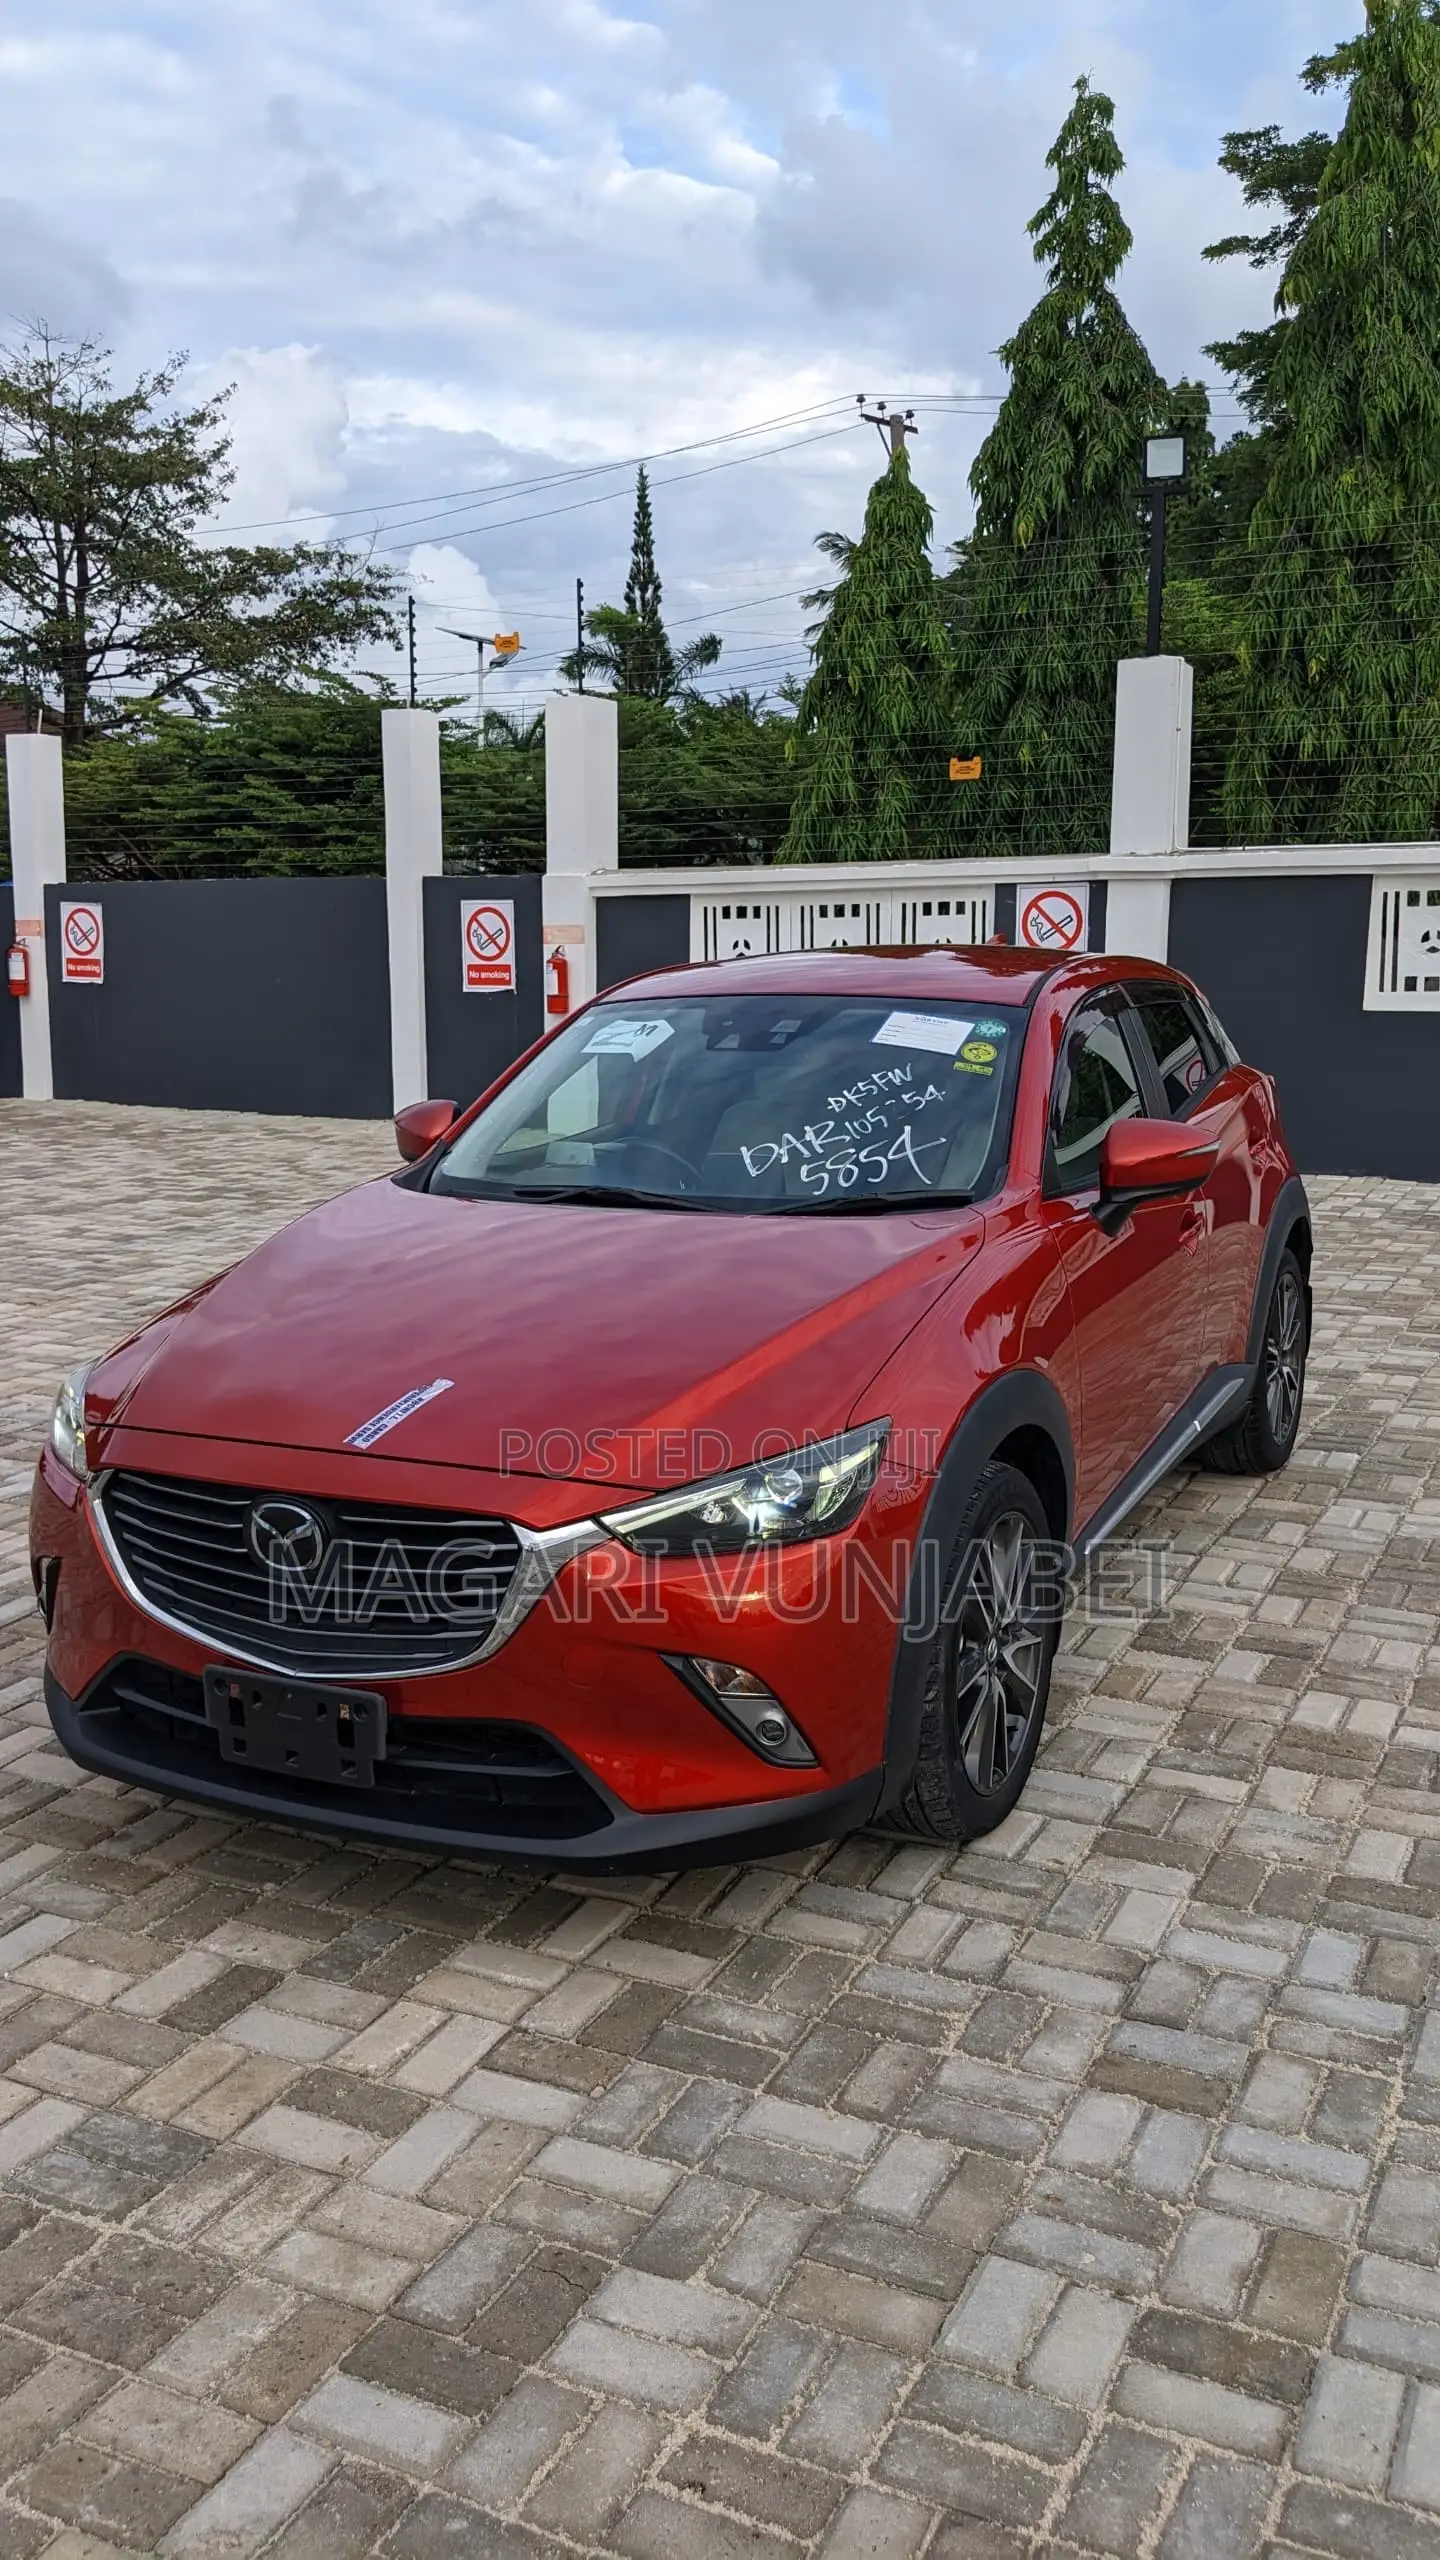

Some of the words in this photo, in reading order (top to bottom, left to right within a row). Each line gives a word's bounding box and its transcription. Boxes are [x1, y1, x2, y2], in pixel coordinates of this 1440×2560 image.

[68, 963, 76, 971] No
[77, 963, 100, 974] smoking
[469, 970, 480, 979] No
[480, 970, 510, 981] smoking
[740, 1120, 850, 1177] DAR
[799, 1125, 948, 1195] 5854
[361, 1422, 389, 1443] CARGO
